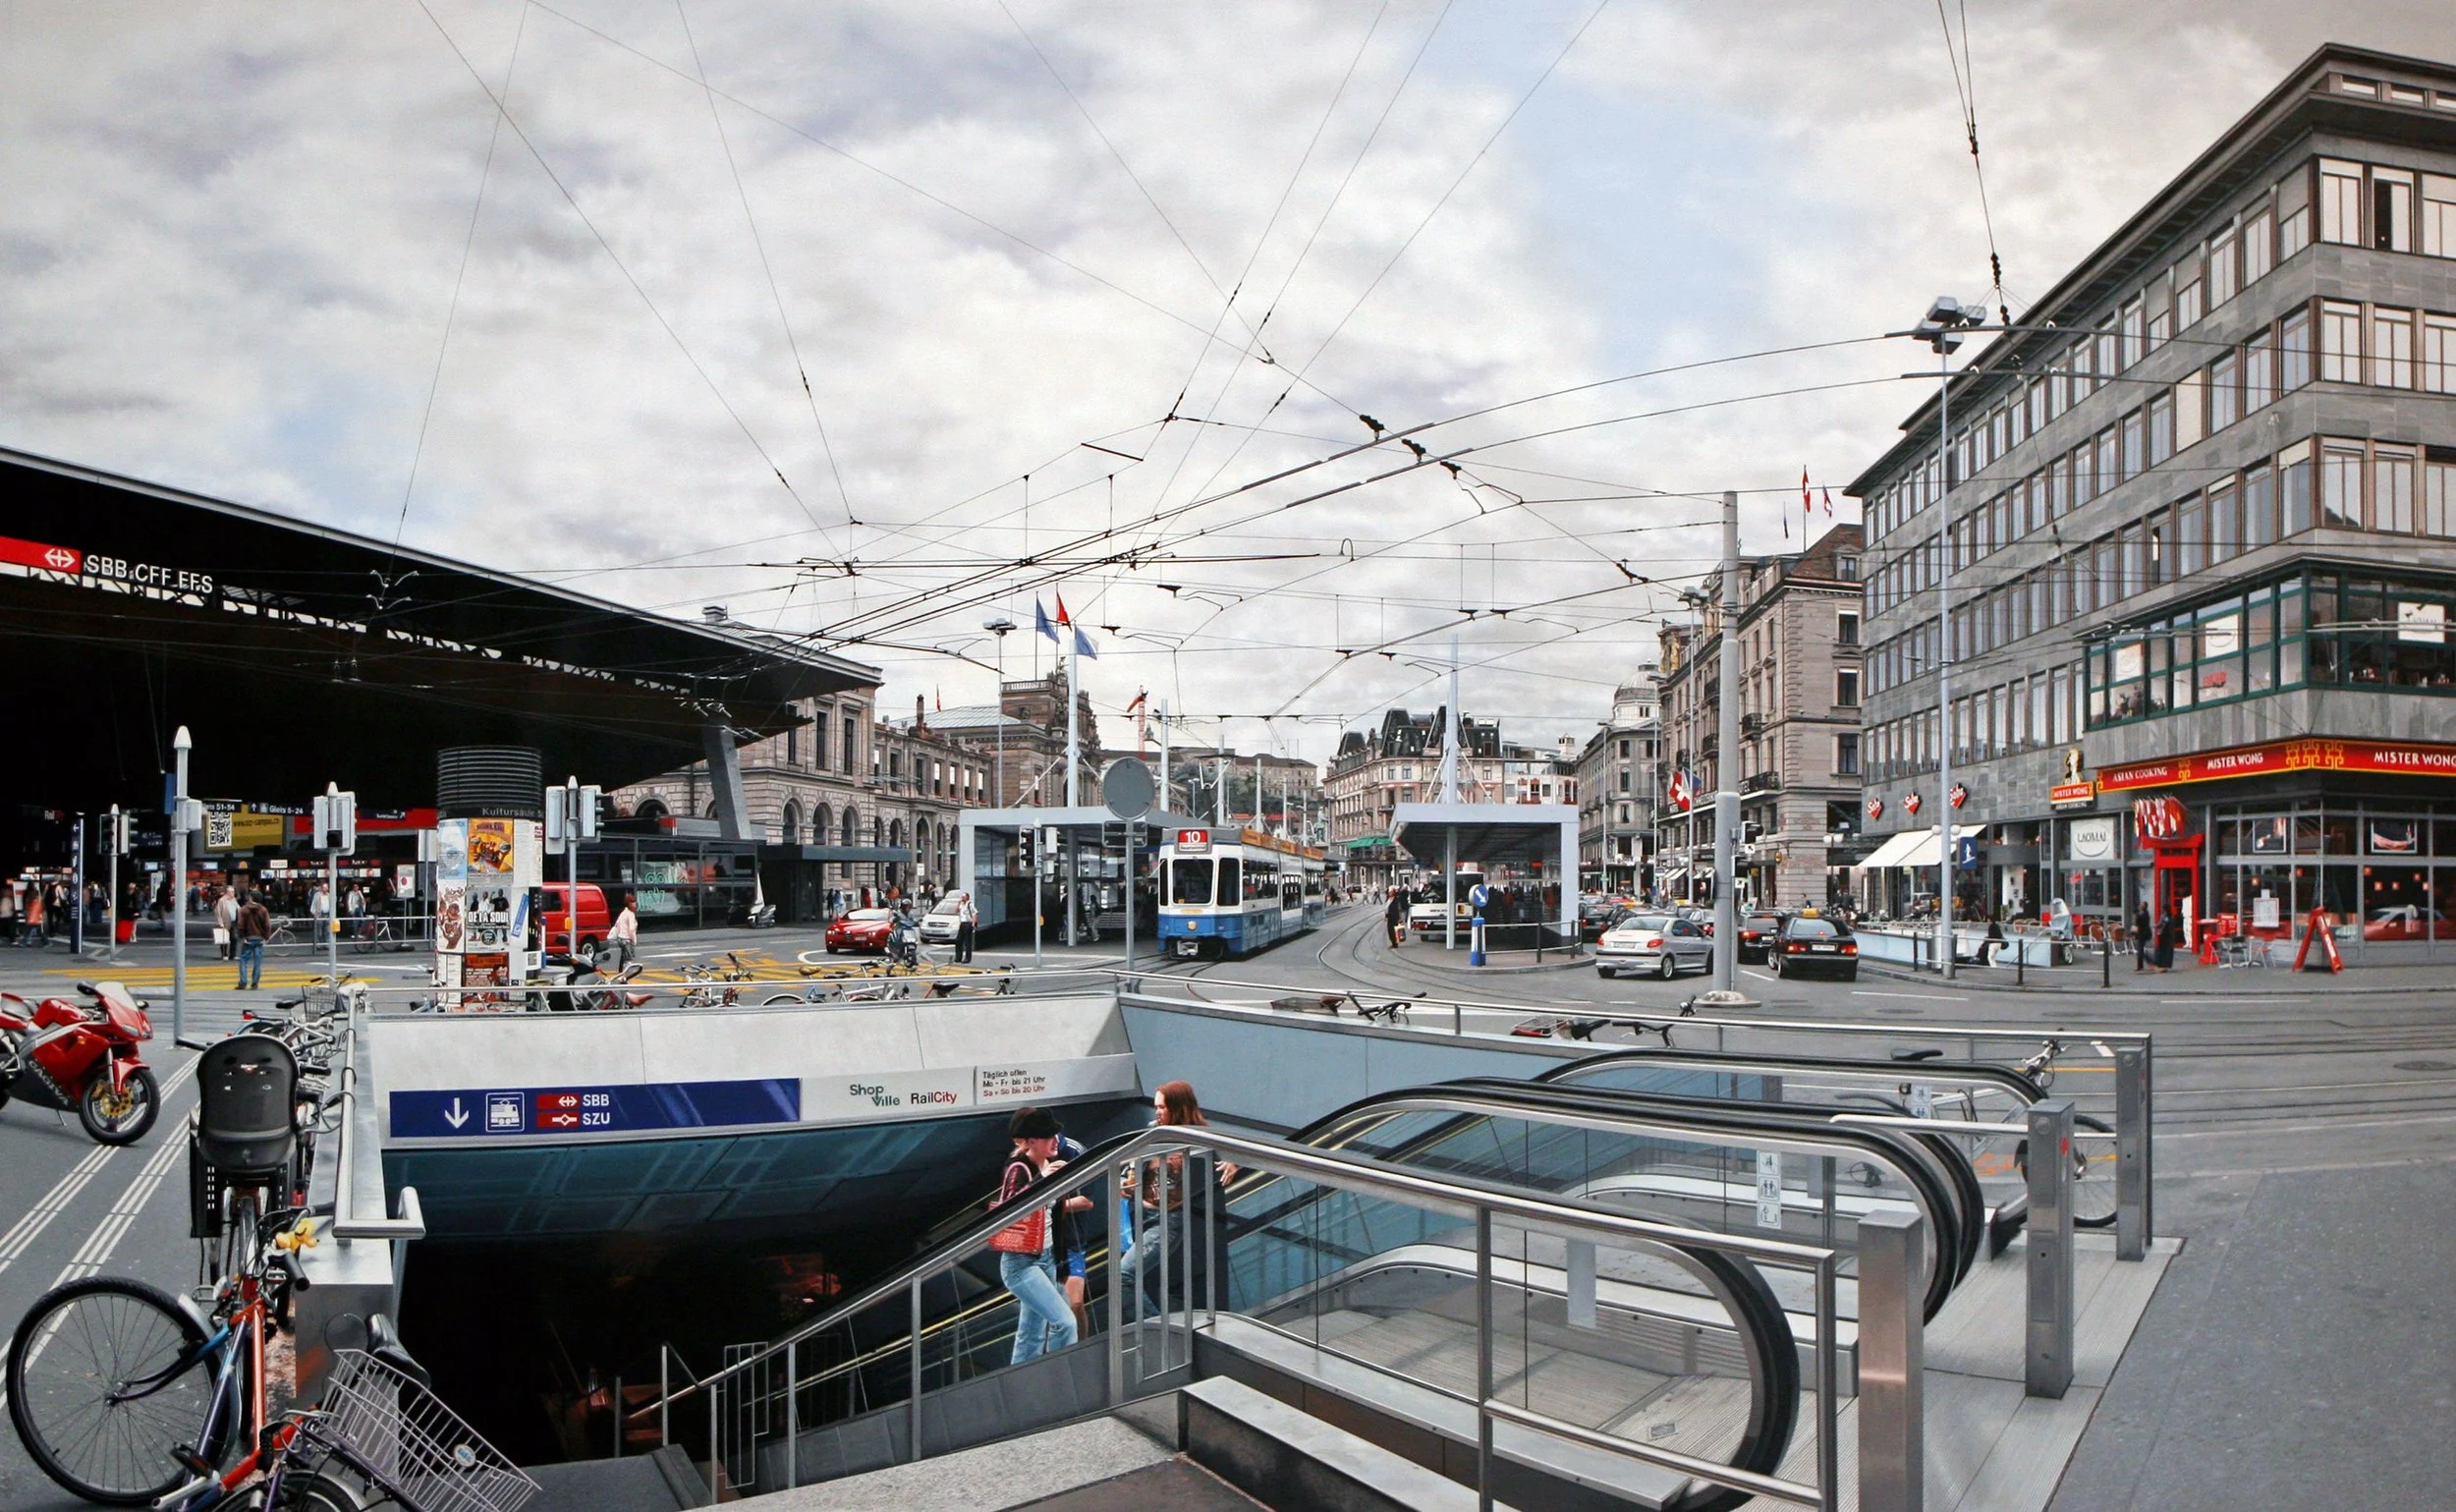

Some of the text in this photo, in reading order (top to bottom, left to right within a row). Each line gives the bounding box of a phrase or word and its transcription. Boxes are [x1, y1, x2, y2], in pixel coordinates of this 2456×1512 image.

[86, 554, 213, 593] SBB CFF FFS
[2206, 753, 2263, 770] MISTER WONG
[2374, 752, 2456, 766] MISTER WONG
[2113, 766, 2168, 782] ASIAN COOKING
[269, 805, 286, 814] Gleis
[1185, 830, 1201, 843] 10
[2077, 831, 2106, 843] LAOMAI
[468, 911, 510, 924] DE LA SOUL
[982, 1070, 1008, 1080] Täglich
[583, 1093, 610, 1106] SBB
[850, 1084, 901, 1107] Shop Ville
[910, 1091, 958, 1105] RailCity
[583, 1111, 610, 1126] SZU
